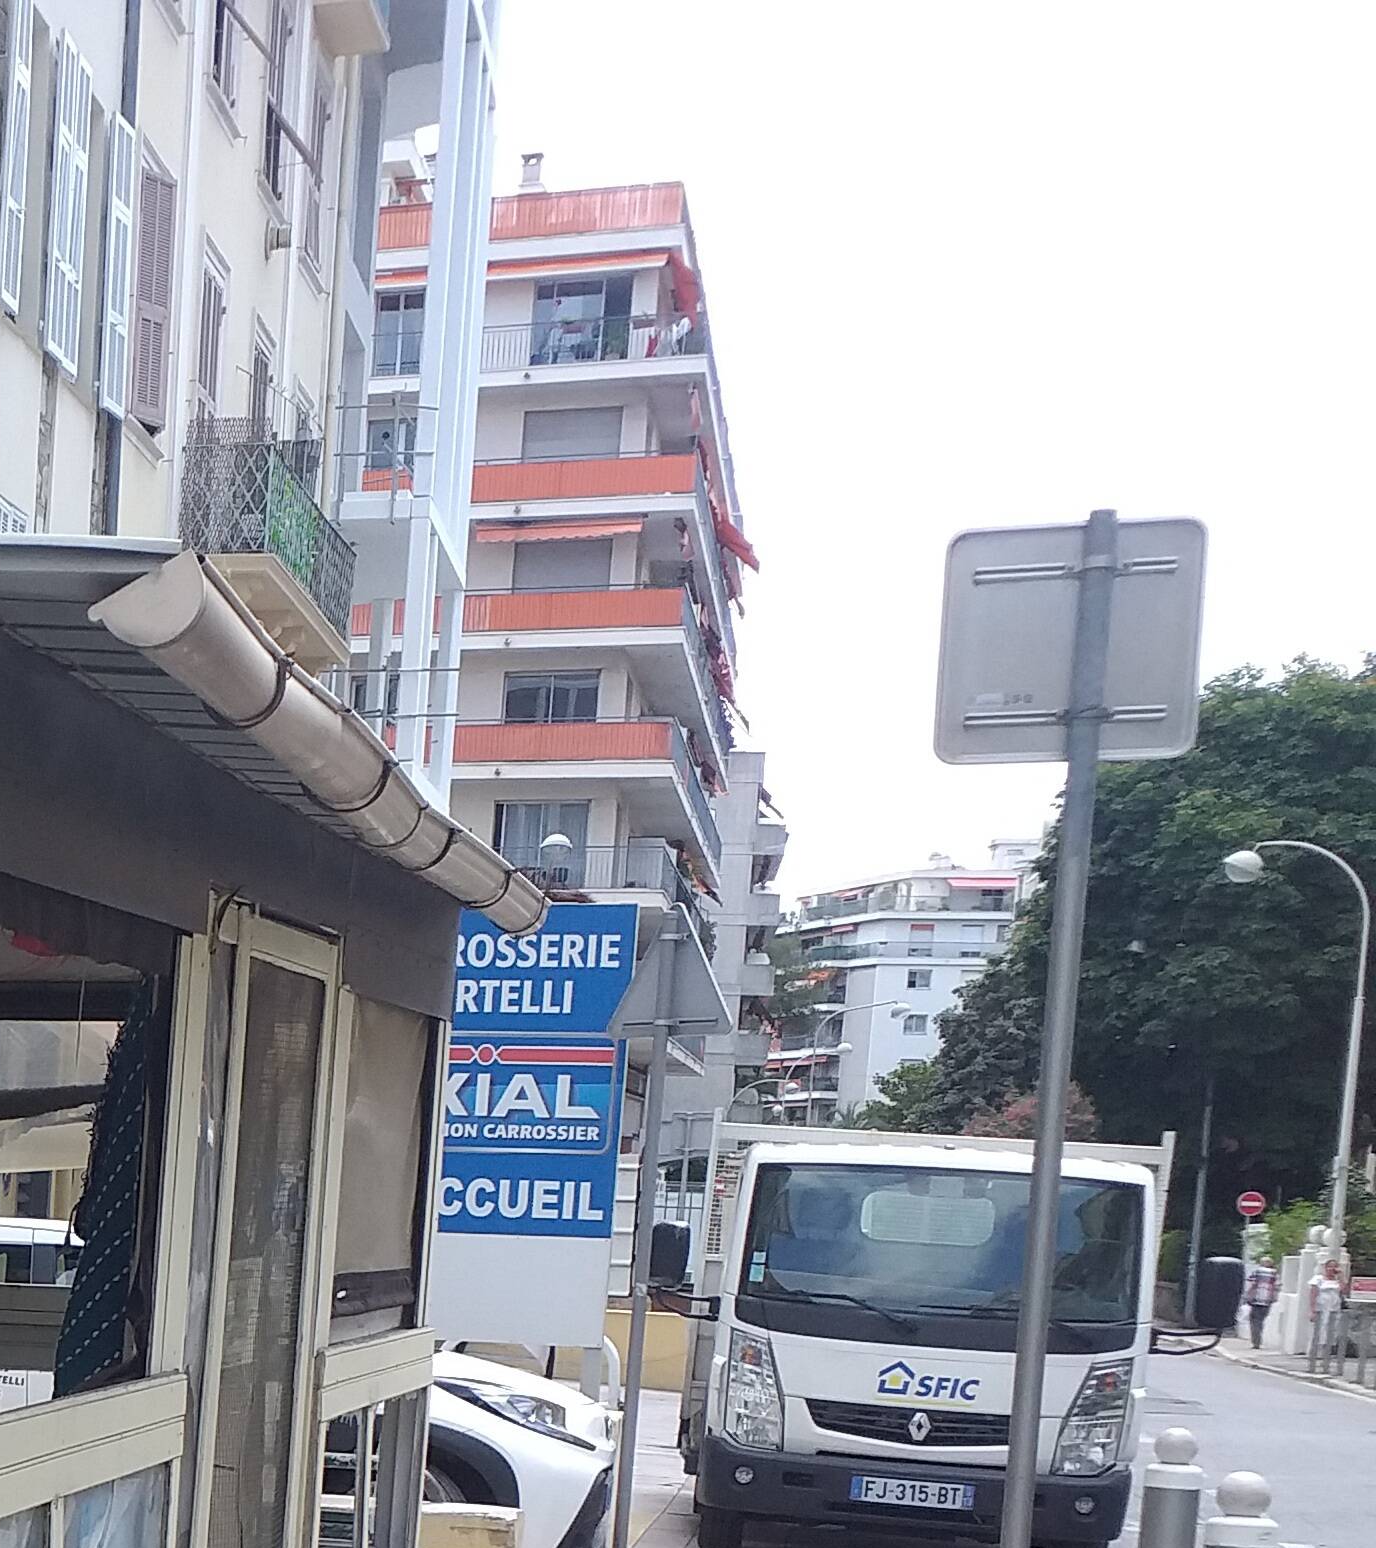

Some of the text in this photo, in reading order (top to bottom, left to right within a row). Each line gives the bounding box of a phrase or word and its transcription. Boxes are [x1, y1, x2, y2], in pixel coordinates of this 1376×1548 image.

[456, 979, 574, 1015] RTELLI
[483, 1123, 600, 1142] CARROSSIER
[438, 1176, 604, 1221] CCUEIL
[915, 1376, 980, 1400] SFIC
[863, 1480, 961, 1505] FJ-315-BT
